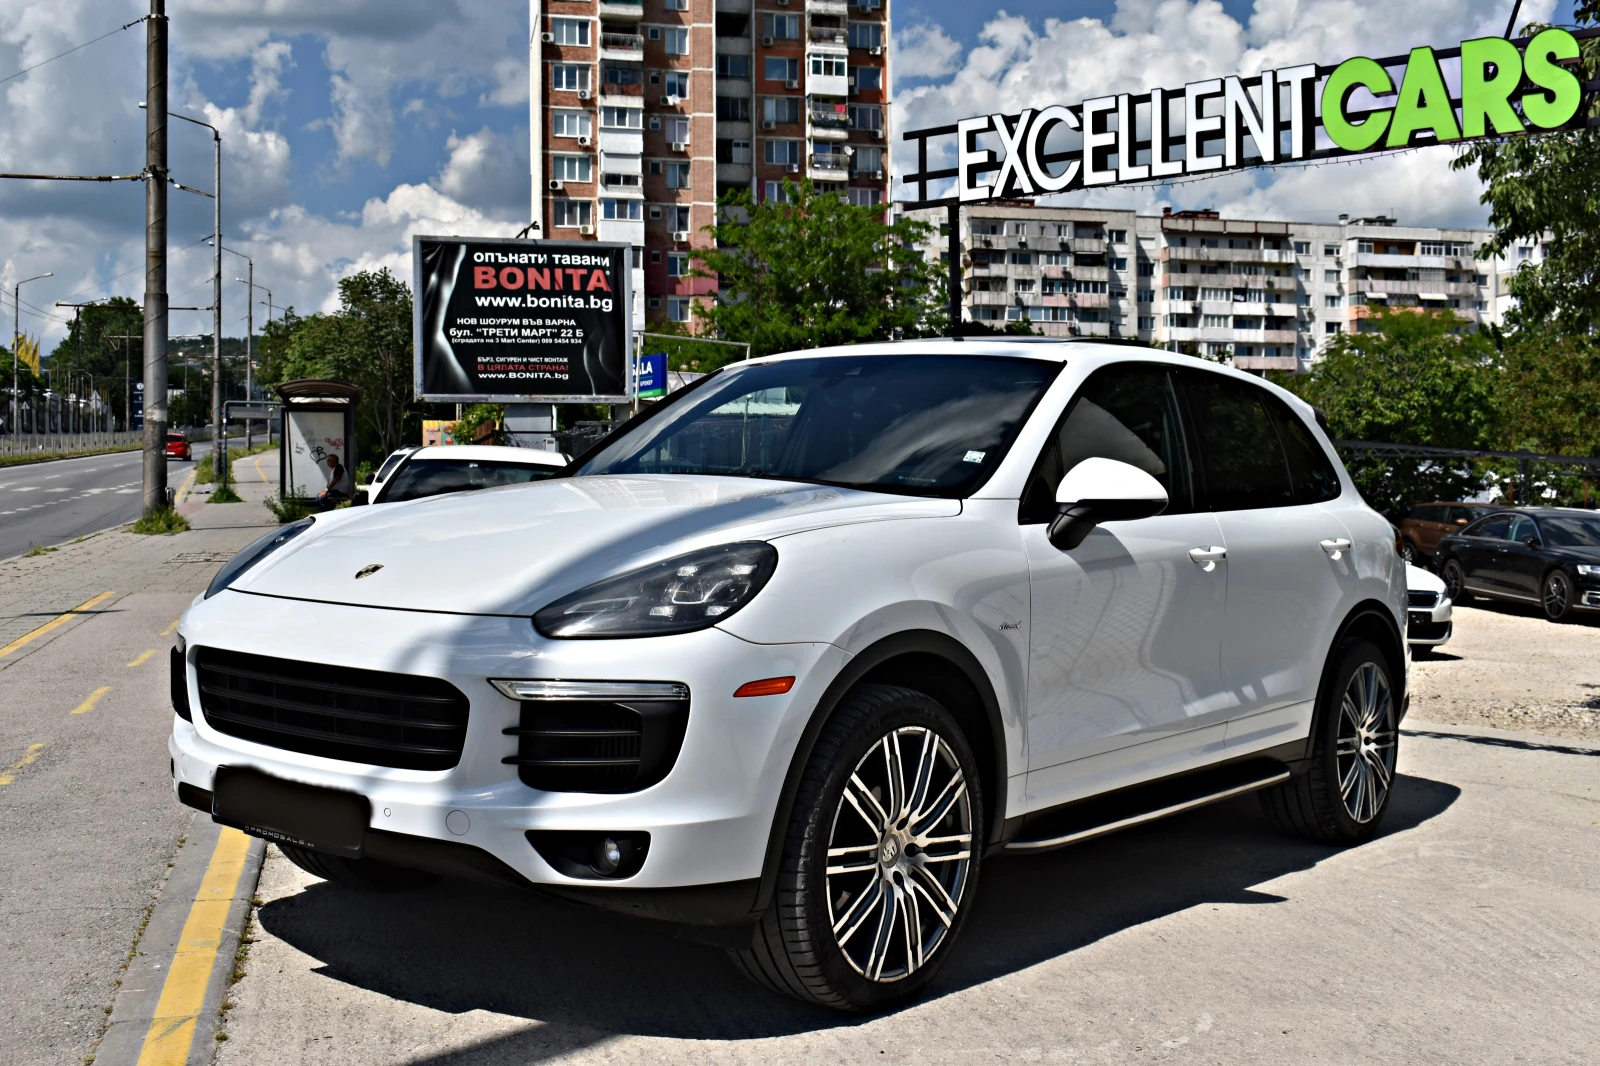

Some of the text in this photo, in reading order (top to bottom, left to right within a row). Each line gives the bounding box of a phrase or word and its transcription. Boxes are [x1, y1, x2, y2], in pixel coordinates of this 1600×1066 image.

[957, 28, 1582, 202] EXCELLENT CARS
[473, 252, 610, 267] опънати тавани
[473, 266, 612, 292] BONITA
[474, 294, 613, 312] www.bonita.bg
[456, 317, 478, 325] НОВ
[480, 318, 520, 326] ШОУРУМ
[522, 318, 543, 326] ВЪВ
[449, 327, 474, 338] бул.
[560, 328, 573, 338] 22
[575, 328, 584, 338] Б
[487, 364, 526, 372] ЦЯЛАТА
[478, 372, 569, 380] www.BONITA.bg
